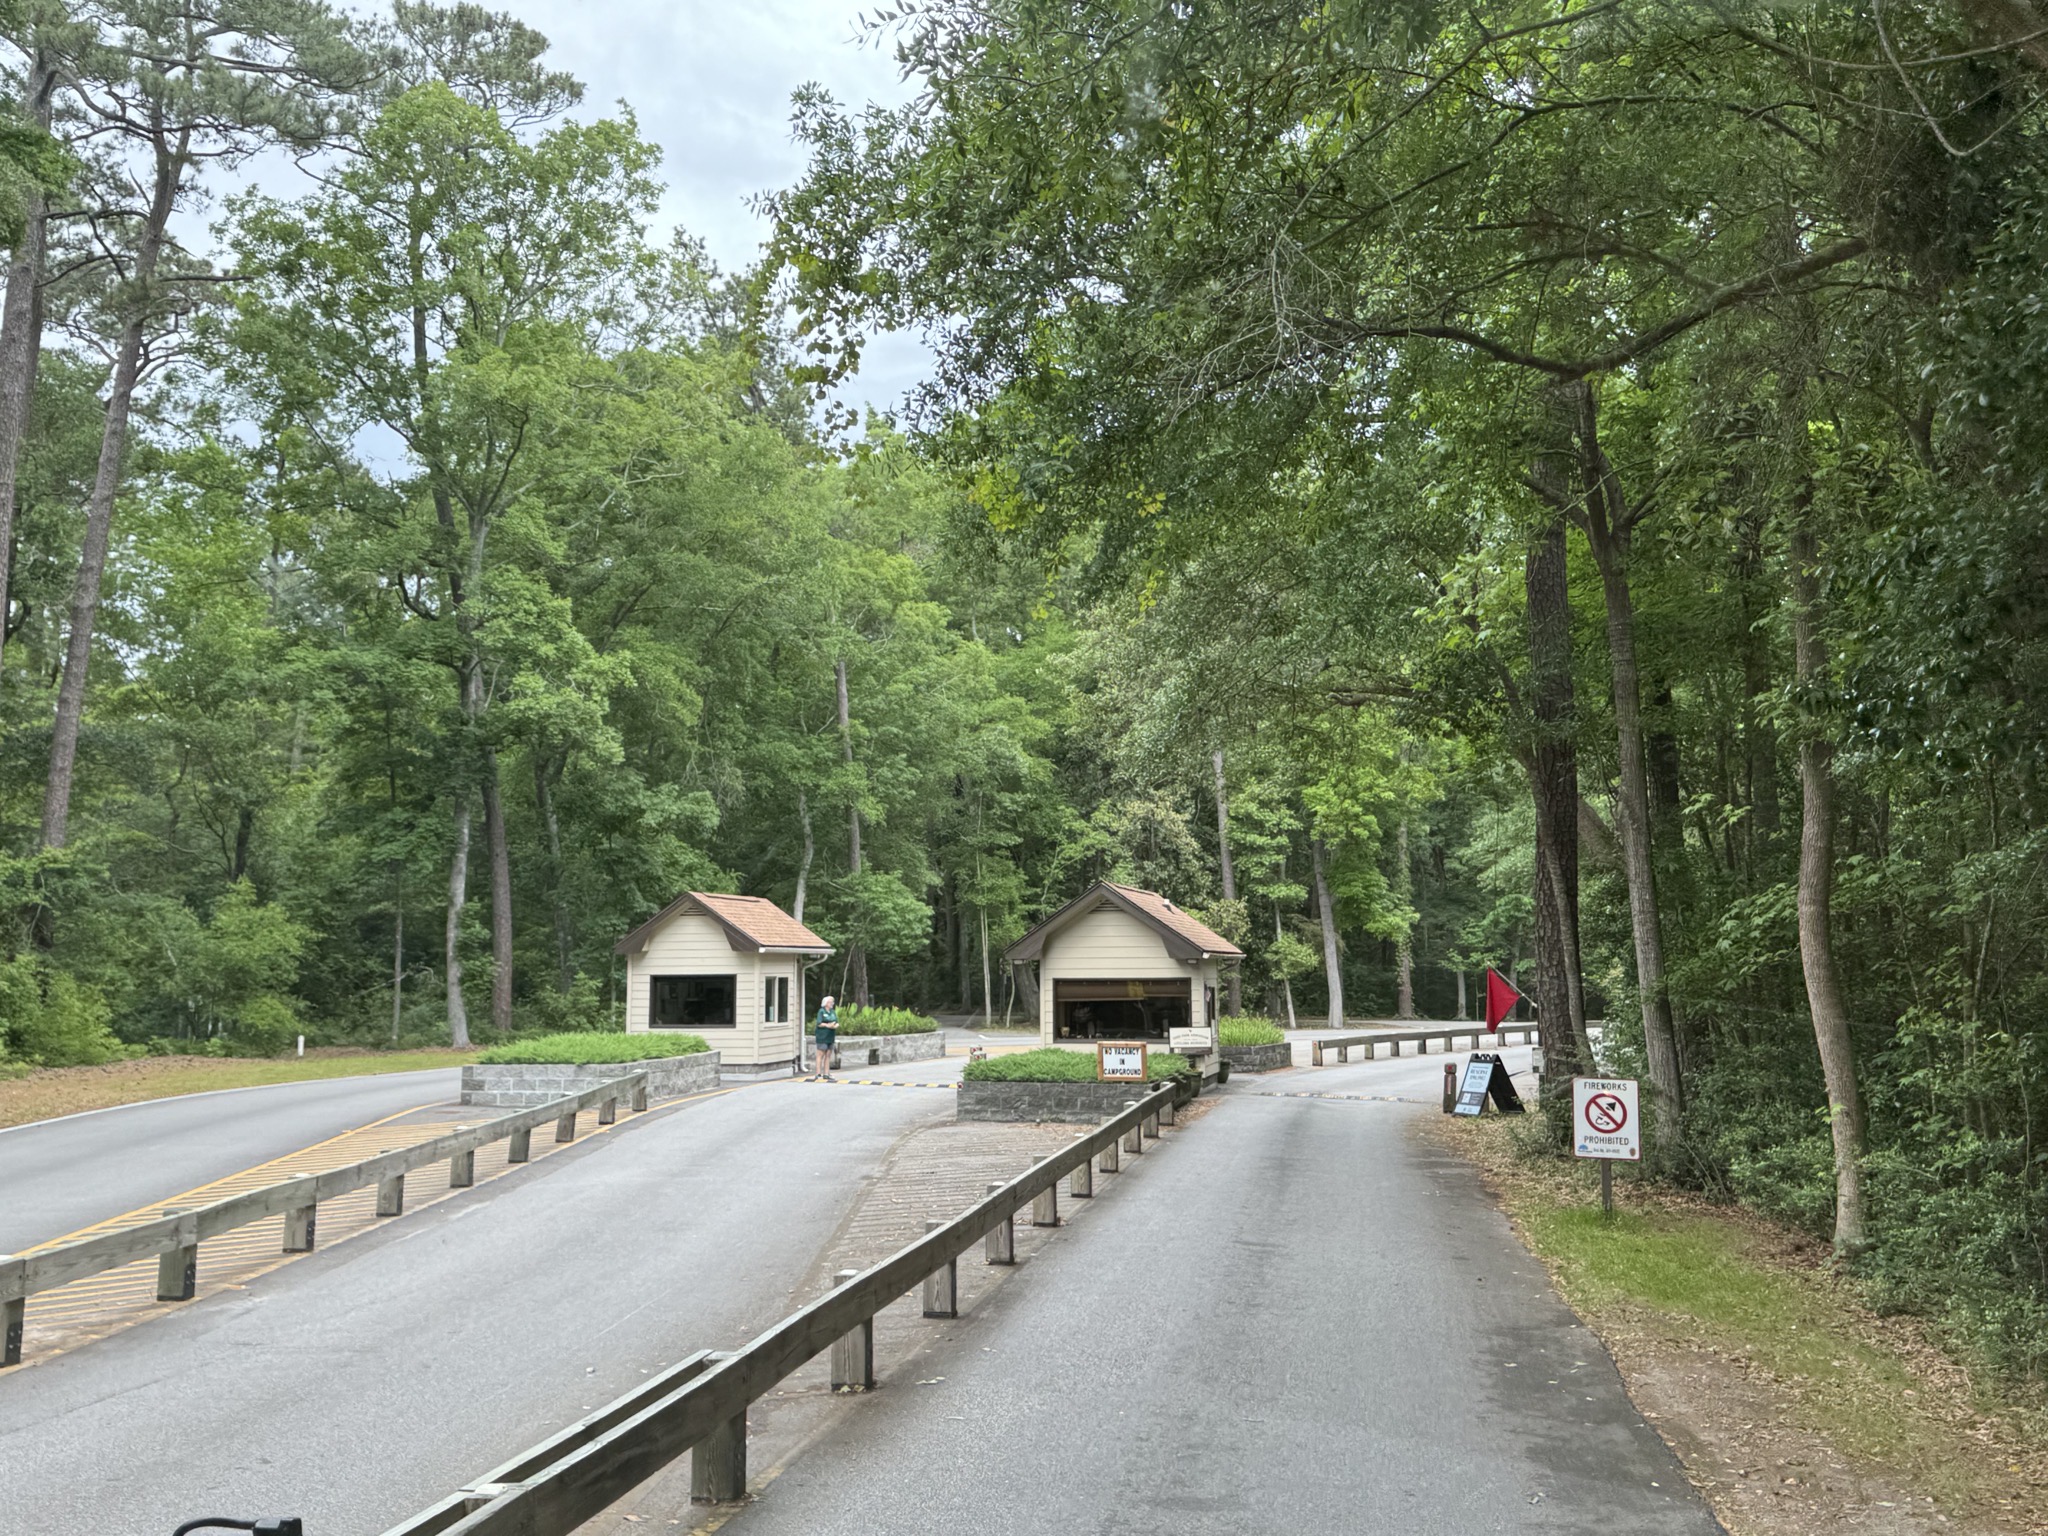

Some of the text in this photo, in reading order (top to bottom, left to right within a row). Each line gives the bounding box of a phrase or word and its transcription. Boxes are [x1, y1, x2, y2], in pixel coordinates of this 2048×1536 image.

[1114, 1047, 1140, 1055] VACANCY
[1103, 1068, 1141, 1076] CAMPGROUND
[1584, 1081, 1627, 1091] FIREWORKS
[1584, 1136, 1629, 1146] PROHIBITED
